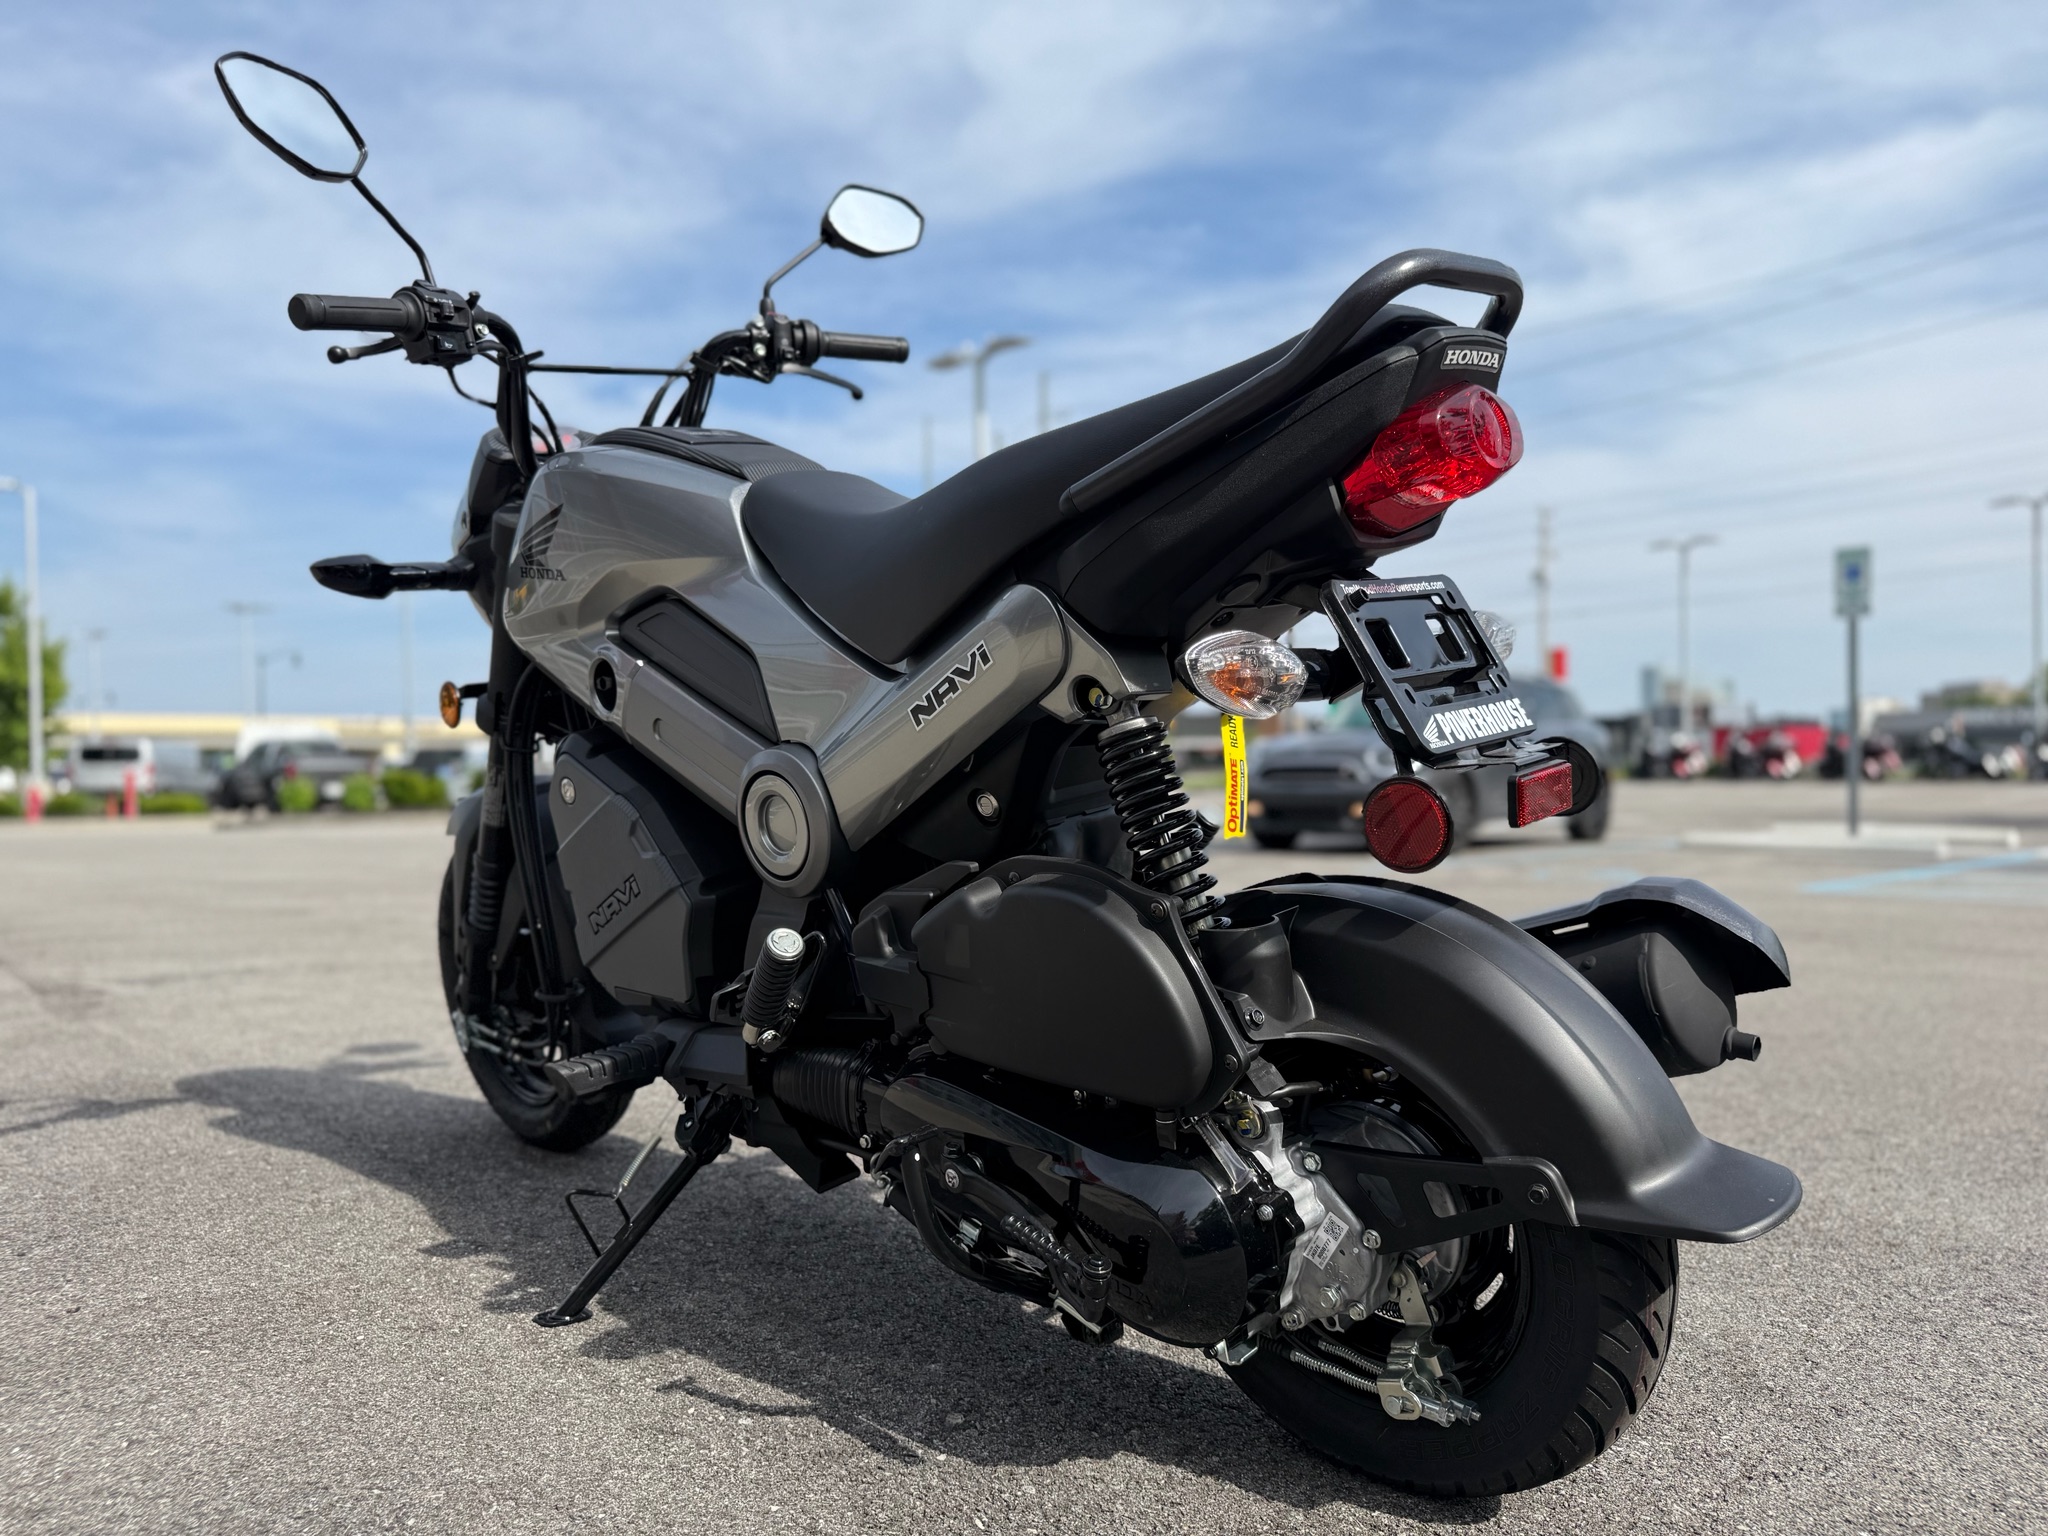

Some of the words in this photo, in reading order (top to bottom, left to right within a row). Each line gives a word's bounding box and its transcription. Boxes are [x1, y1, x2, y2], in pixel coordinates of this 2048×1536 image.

[1443, 349, 1500, 368] HONDA
[520, 566, 567, 581] HONDA
[1340, 581, 1445, 595] TomWodHondaPowersports.com
[1434, 697, 1534, 744] POWERHOUSE
[1228, 714, 1239, 749] READY
[1429, 740, 1450, 749] HONDA
